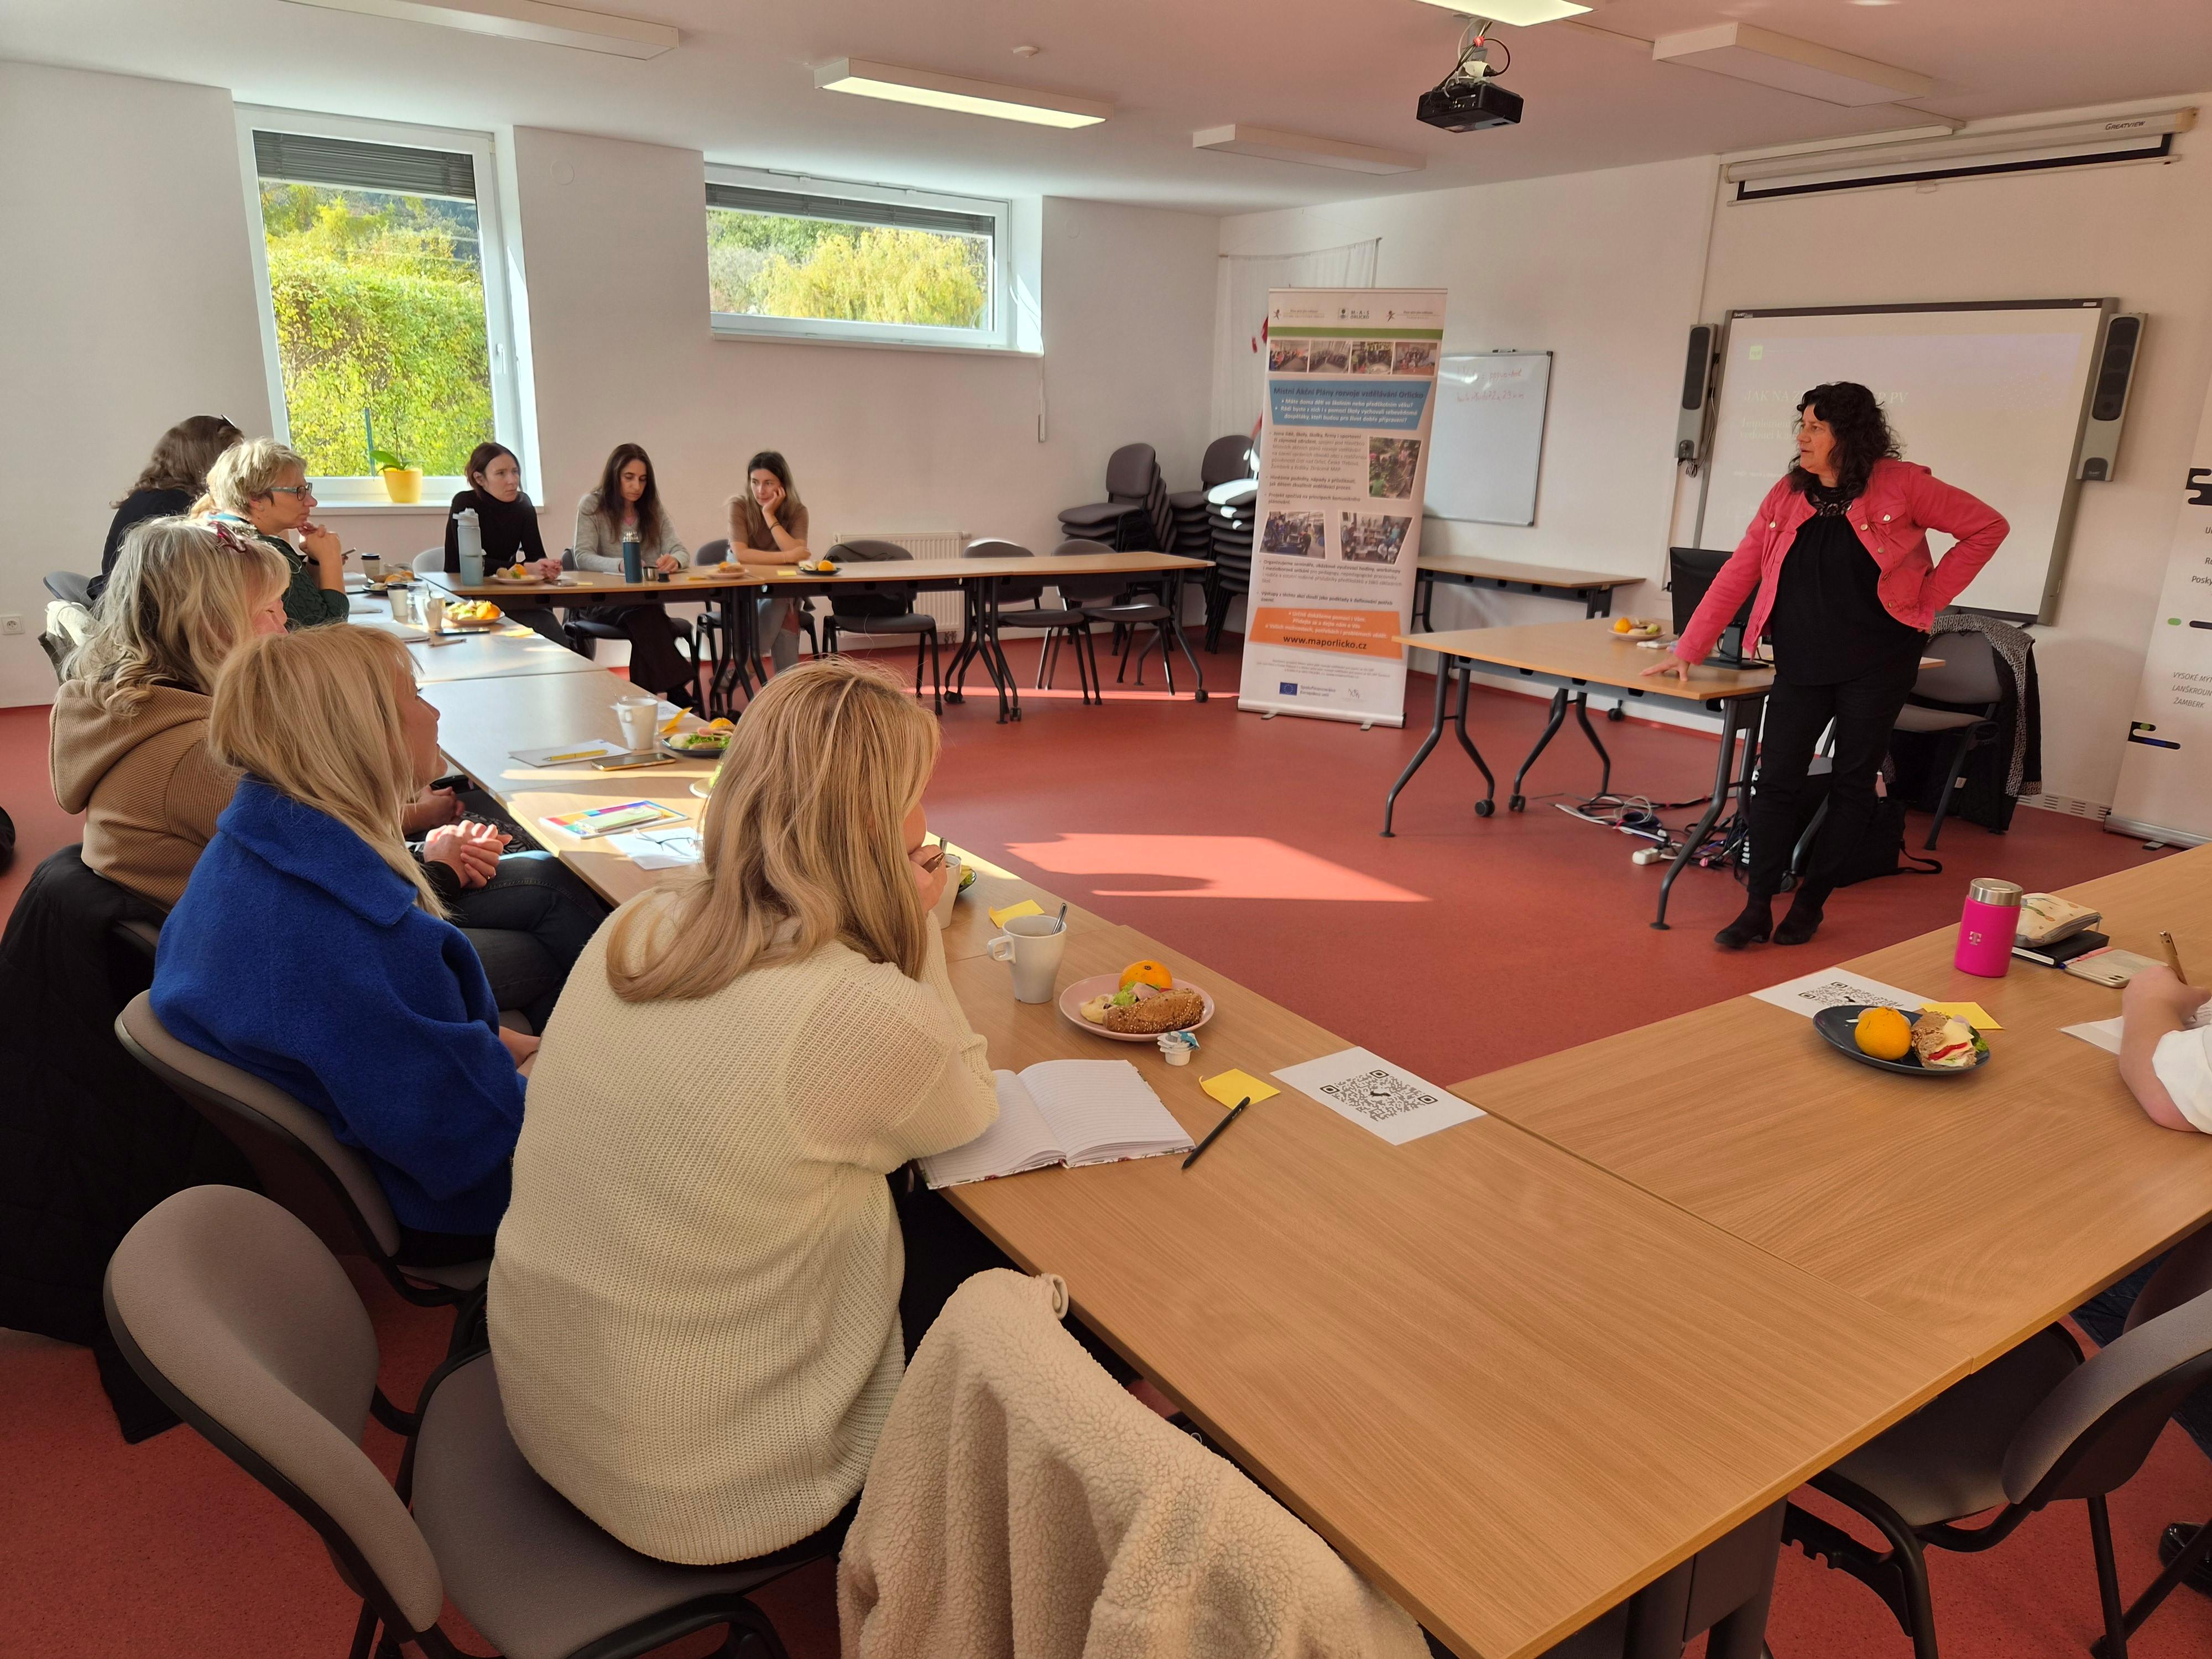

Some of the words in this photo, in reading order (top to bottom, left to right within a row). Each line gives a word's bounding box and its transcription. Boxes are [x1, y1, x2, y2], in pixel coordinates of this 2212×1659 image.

[2105, 121, 2146, 131] GREATVIEW
[1283, 636, 1367, 650] www.maporlicko.cz
[2173, 671, 2199, 681] VYSOKÉ
[2172, 684, 2212, 696] LANŠKROUN
[2173, 696, 2206, 708] ŽAMBERK
